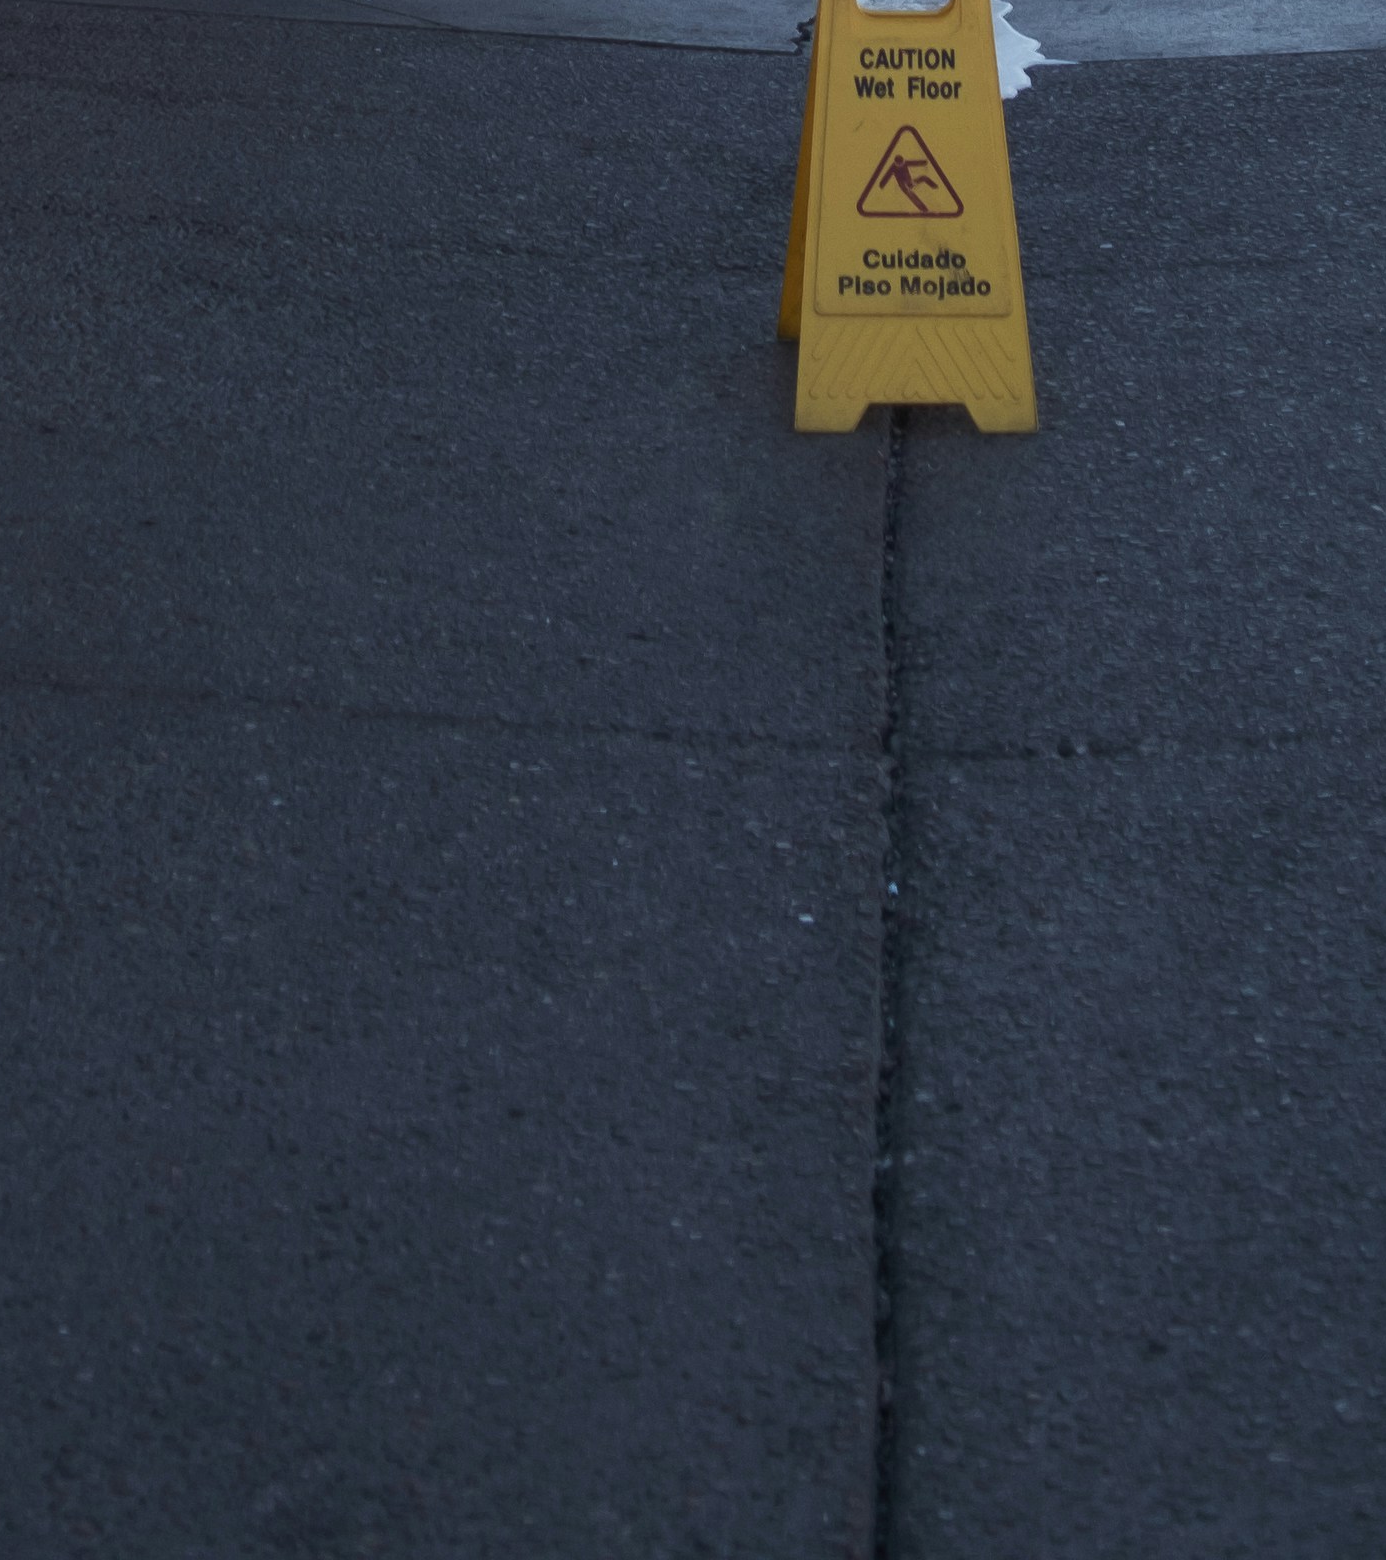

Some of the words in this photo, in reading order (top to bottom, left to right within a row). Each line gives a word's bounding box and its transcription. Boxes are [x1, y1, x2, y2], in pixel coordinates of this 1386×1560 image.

[859, 47, 956, 70] CAUTION
[854, 76, 895, 99] Wet
[907, 76, 962, 100] Floor
[862, 248, 967, 270] Cuidado
[838, 275, 892, 296] Piso
[900, 275, 992, 301] Mojado
